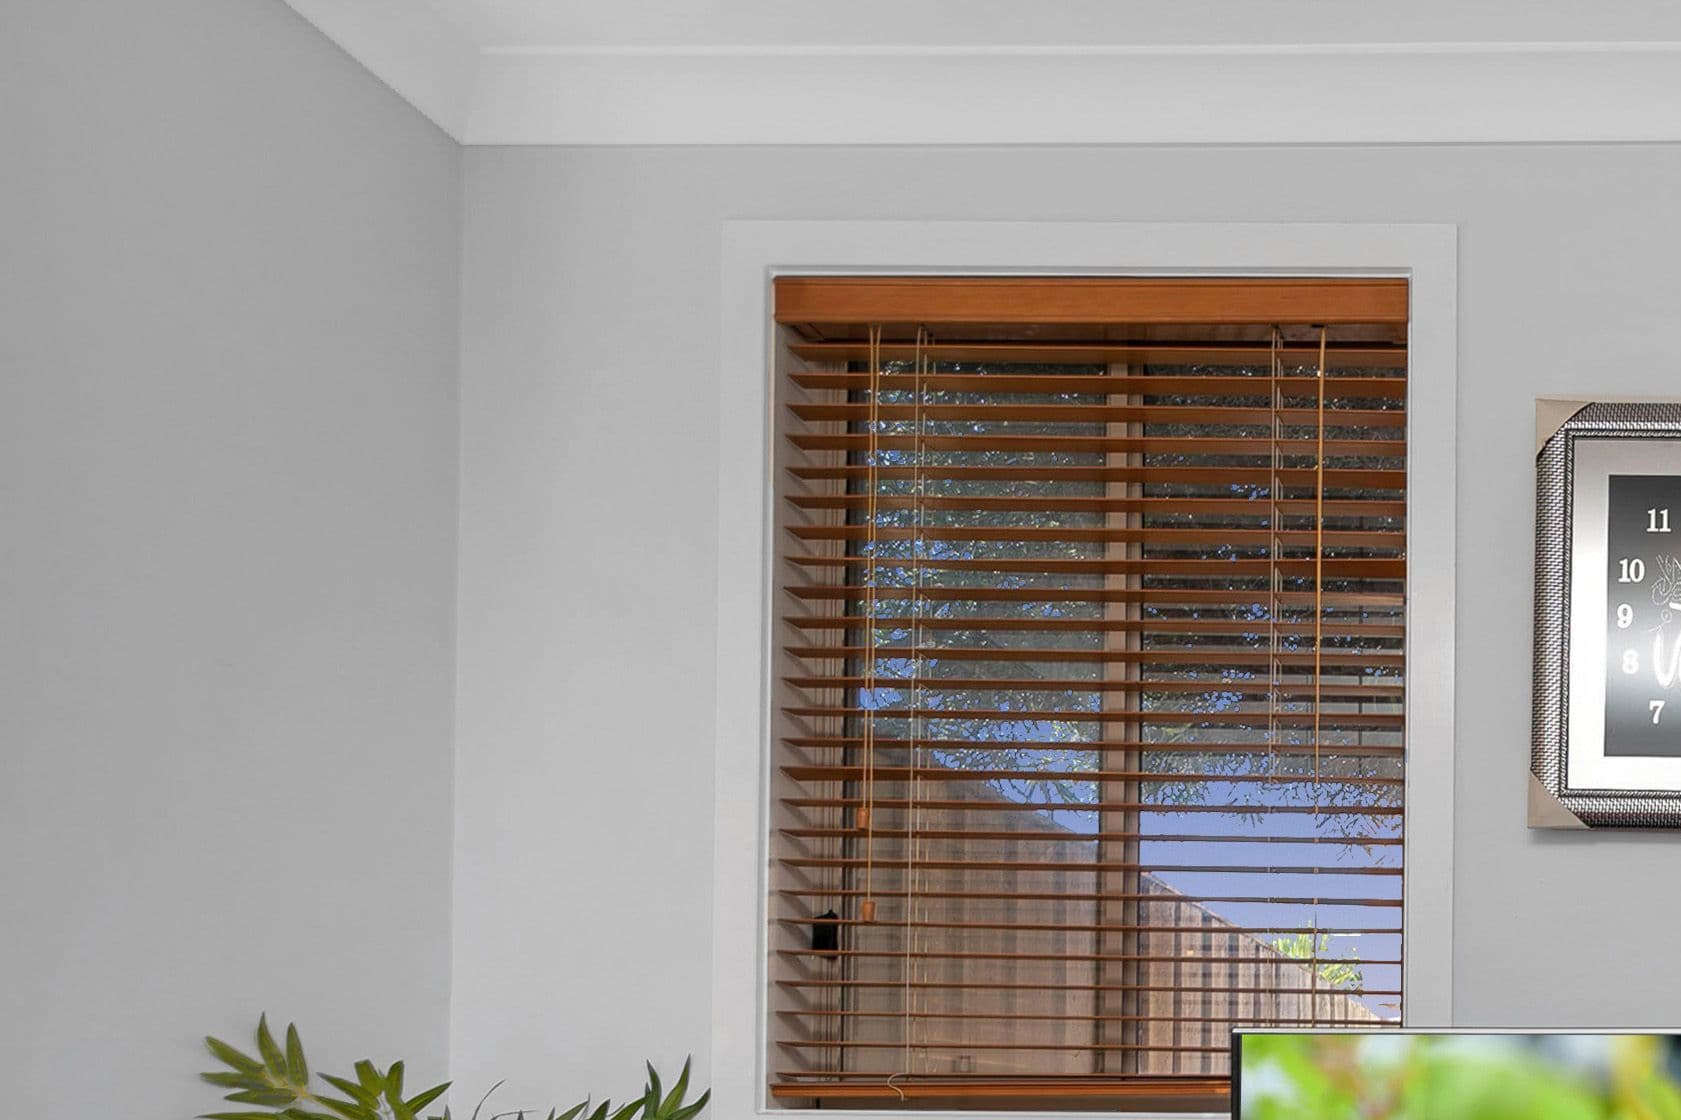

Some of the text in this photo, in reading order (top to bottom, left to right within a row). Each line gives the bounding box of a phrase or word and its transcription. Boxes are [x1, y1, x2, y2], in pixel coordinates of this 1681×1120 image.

[1646, 508, 1672, 532] 11
[1618, 558, 1645, 583] 10
[1617, 603, 1634, 629] 9
[1622, 649, 1639, 675] 8
[1649, 700, 1666, 724] 7
